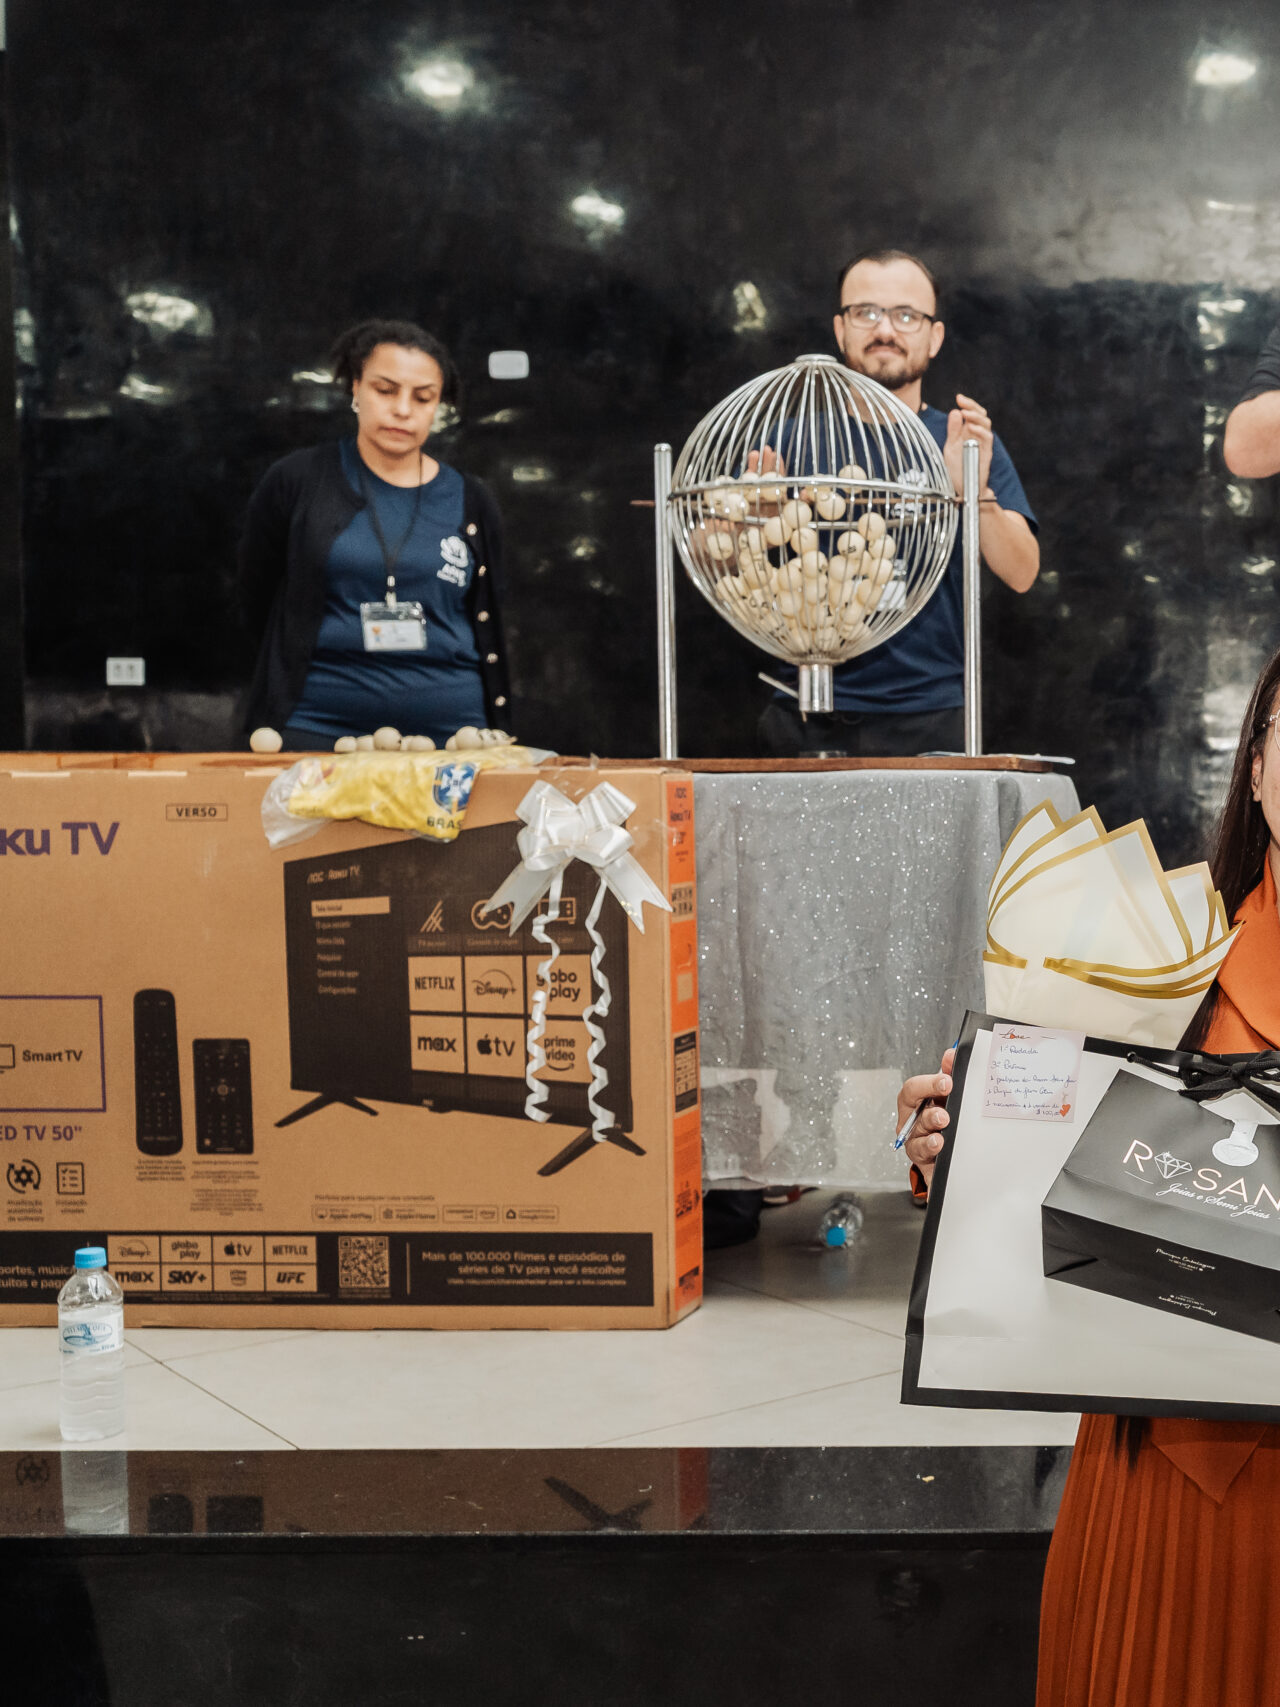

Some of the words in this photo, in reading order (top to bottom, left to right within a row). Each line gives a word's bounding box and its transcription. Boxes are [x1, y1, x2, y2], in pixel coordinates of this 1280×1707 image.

[176, 807, 217, 817] VERSO
[61, 821, 120, 856] TV
[414, 977, 455, 991] NETFLIX
[536, 969, 577, 987] gobo
[549, 986, 581, 1002] play
[417, 1036, 457, 1053] max
[493, 1037, 516, 1056] tv
[543, 1036, 576, 1049] prime
[22, 1050, 63, 1062] Smart
[66, 1050, 83, 1062] TV
[545, 1049, 576, 1061] video
[23, 1125, 46, 1141] TV
[52, 1125, 82, 1141] 50"
[1155, 1182, 1196, 1198] Joias
[1195, 1193, 1204, 1201] e
[1204, 1195, 1241, 1212] Semi
[1230, 1204, 1271, 1219] Joias
[171, 1240, 198, 1251] globo
[236, 1243, 253, 1257] tv
[272, 1245, 308, 1256] NETFLIX
[180, 1250, 200, 1261] play
[422, 1252, 446, 1262] Mais
[449, 1252, 462, 1262] de
[466, 1252, 511, 1263] 100.000
[513, 1252, 546, 1262] filmes
[549, 1254, 556, 1262] e
[558, 1252, 609, 1265] episódios
[612, 1252, 626, 1262] de
[115, 1271, 154, 1283] max
[458, 1264, 488, 1275] séries
[491, 1264, 505, 1275] de
[509, 1265, 524, 1275] TV
[526, 1265, 550, 1278] para
[553, 1263, 579, 1275] você
[581, 1263, 626, 1275] escolher
[276, 1272, 306, 1284] UFC
[31, 1281, 38, 1289] e
